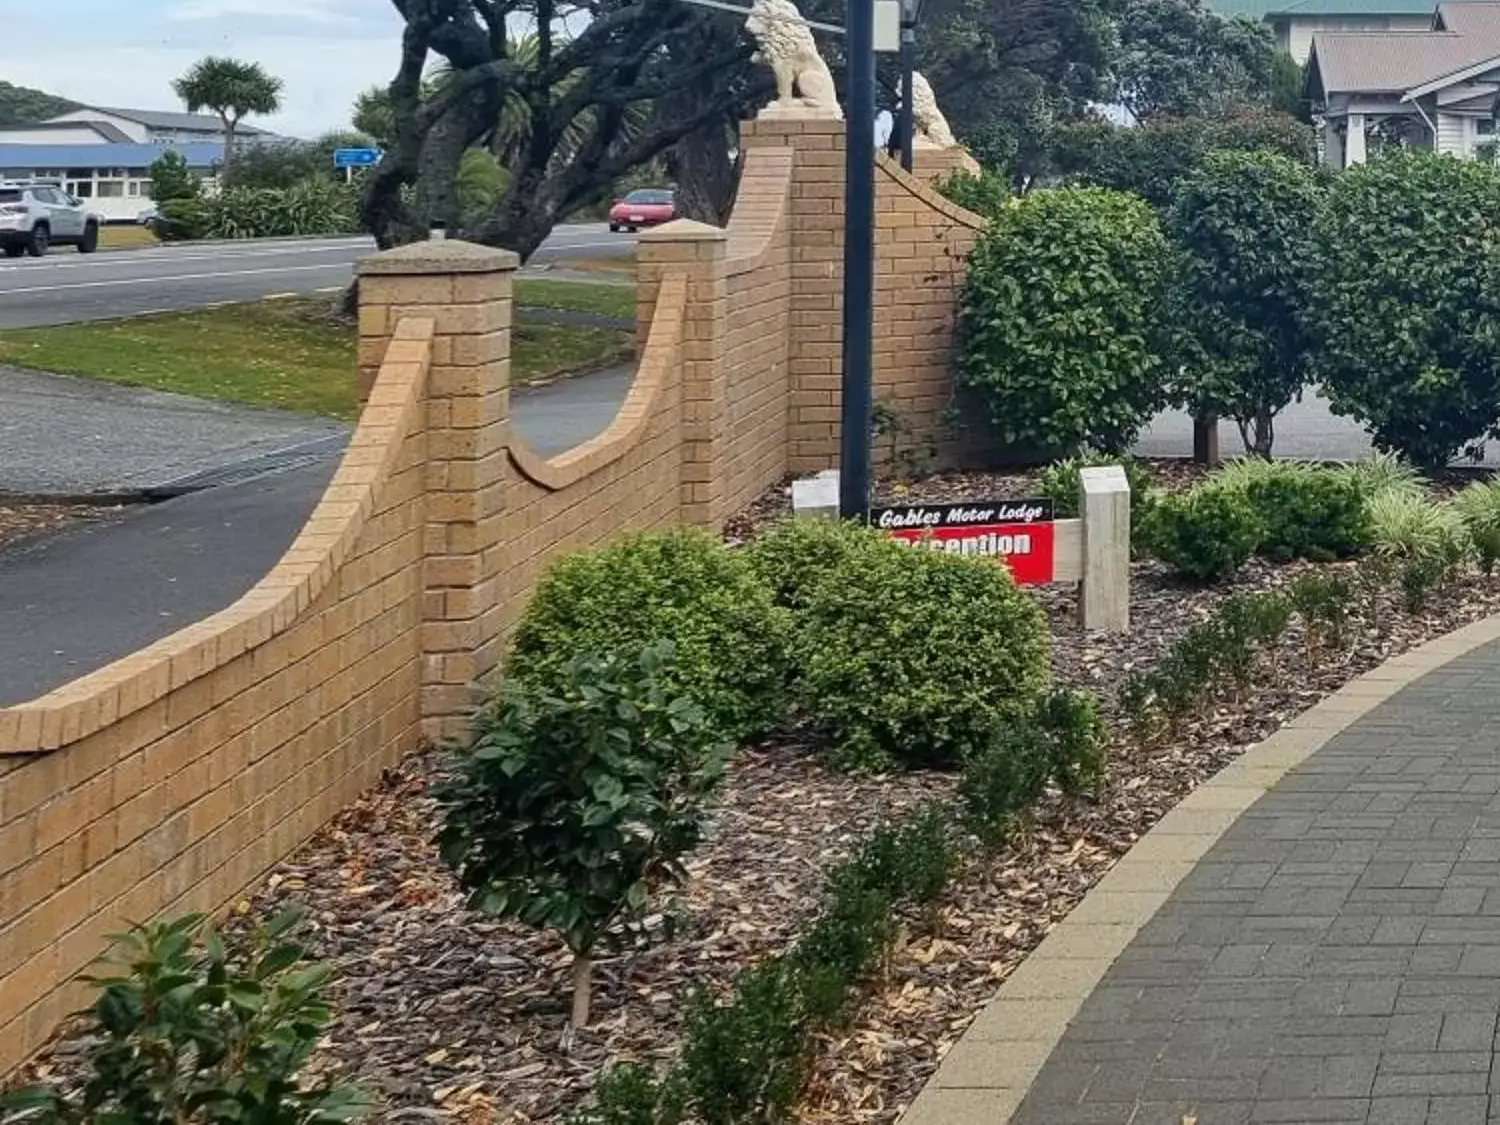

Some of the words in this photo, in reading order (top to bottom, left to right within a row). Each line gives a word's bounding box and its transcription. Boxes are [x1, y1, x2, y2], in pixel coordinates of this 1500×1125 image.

[879, 507, 941, 527] Gables
[945, 507, 995, 522] Motor
[997, 503, 1044, 522] Lodge
